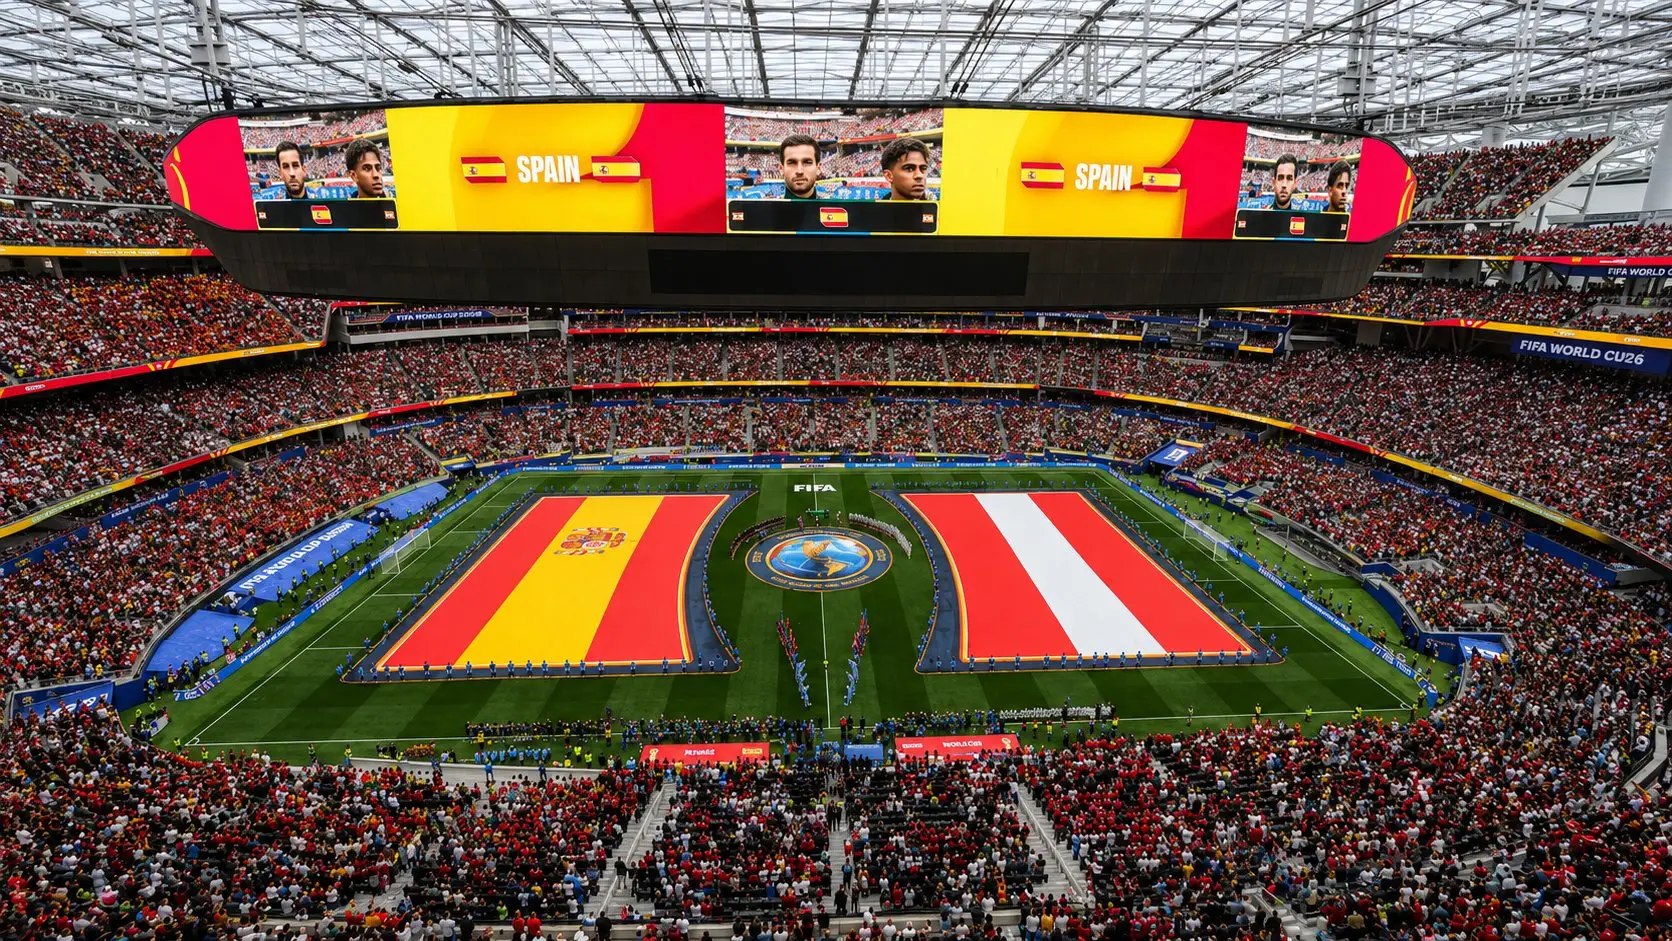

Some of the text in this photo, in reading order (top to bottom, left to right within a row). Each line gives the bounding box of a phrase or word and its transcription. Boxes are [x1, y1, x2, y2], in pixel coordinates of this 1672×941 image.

[516, 155, 581, 183] SPAIN
[1075, 163, 1132, 191] SPAIN
[1607, 267, 1627, 275] FIFA
[1629, 268, 1665, 276] WORLD
[1519, 340, 1645, 365] FIFA WORLD CU26
[794, 484, 837, 492] FIFA
